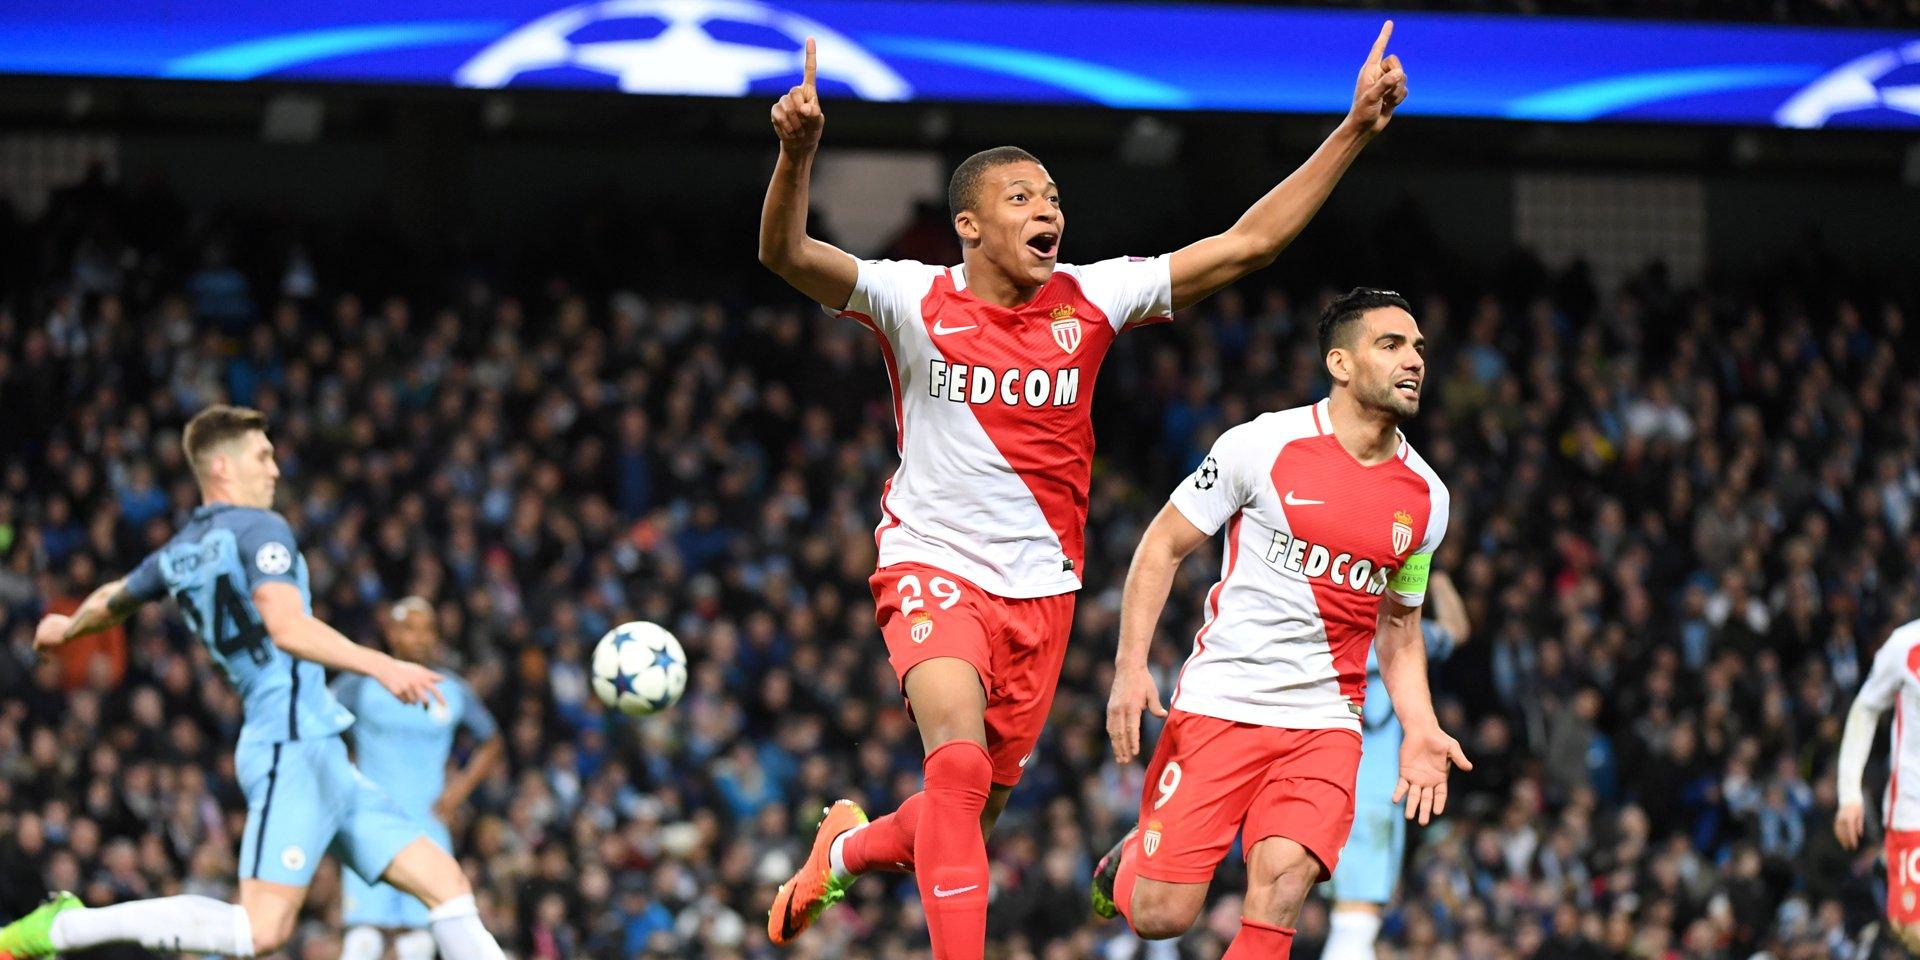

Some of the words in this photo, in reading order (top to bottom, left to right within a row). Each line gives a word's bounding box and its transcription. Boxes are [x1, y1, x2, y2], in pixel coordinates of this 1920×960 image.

[929, 359, 1080, 407] FEDCOM
[1266, 530, 1389, 596] FEDCOM
[896, 574, 962, 618] 29
[1153, 761, 1183, 811] 9
